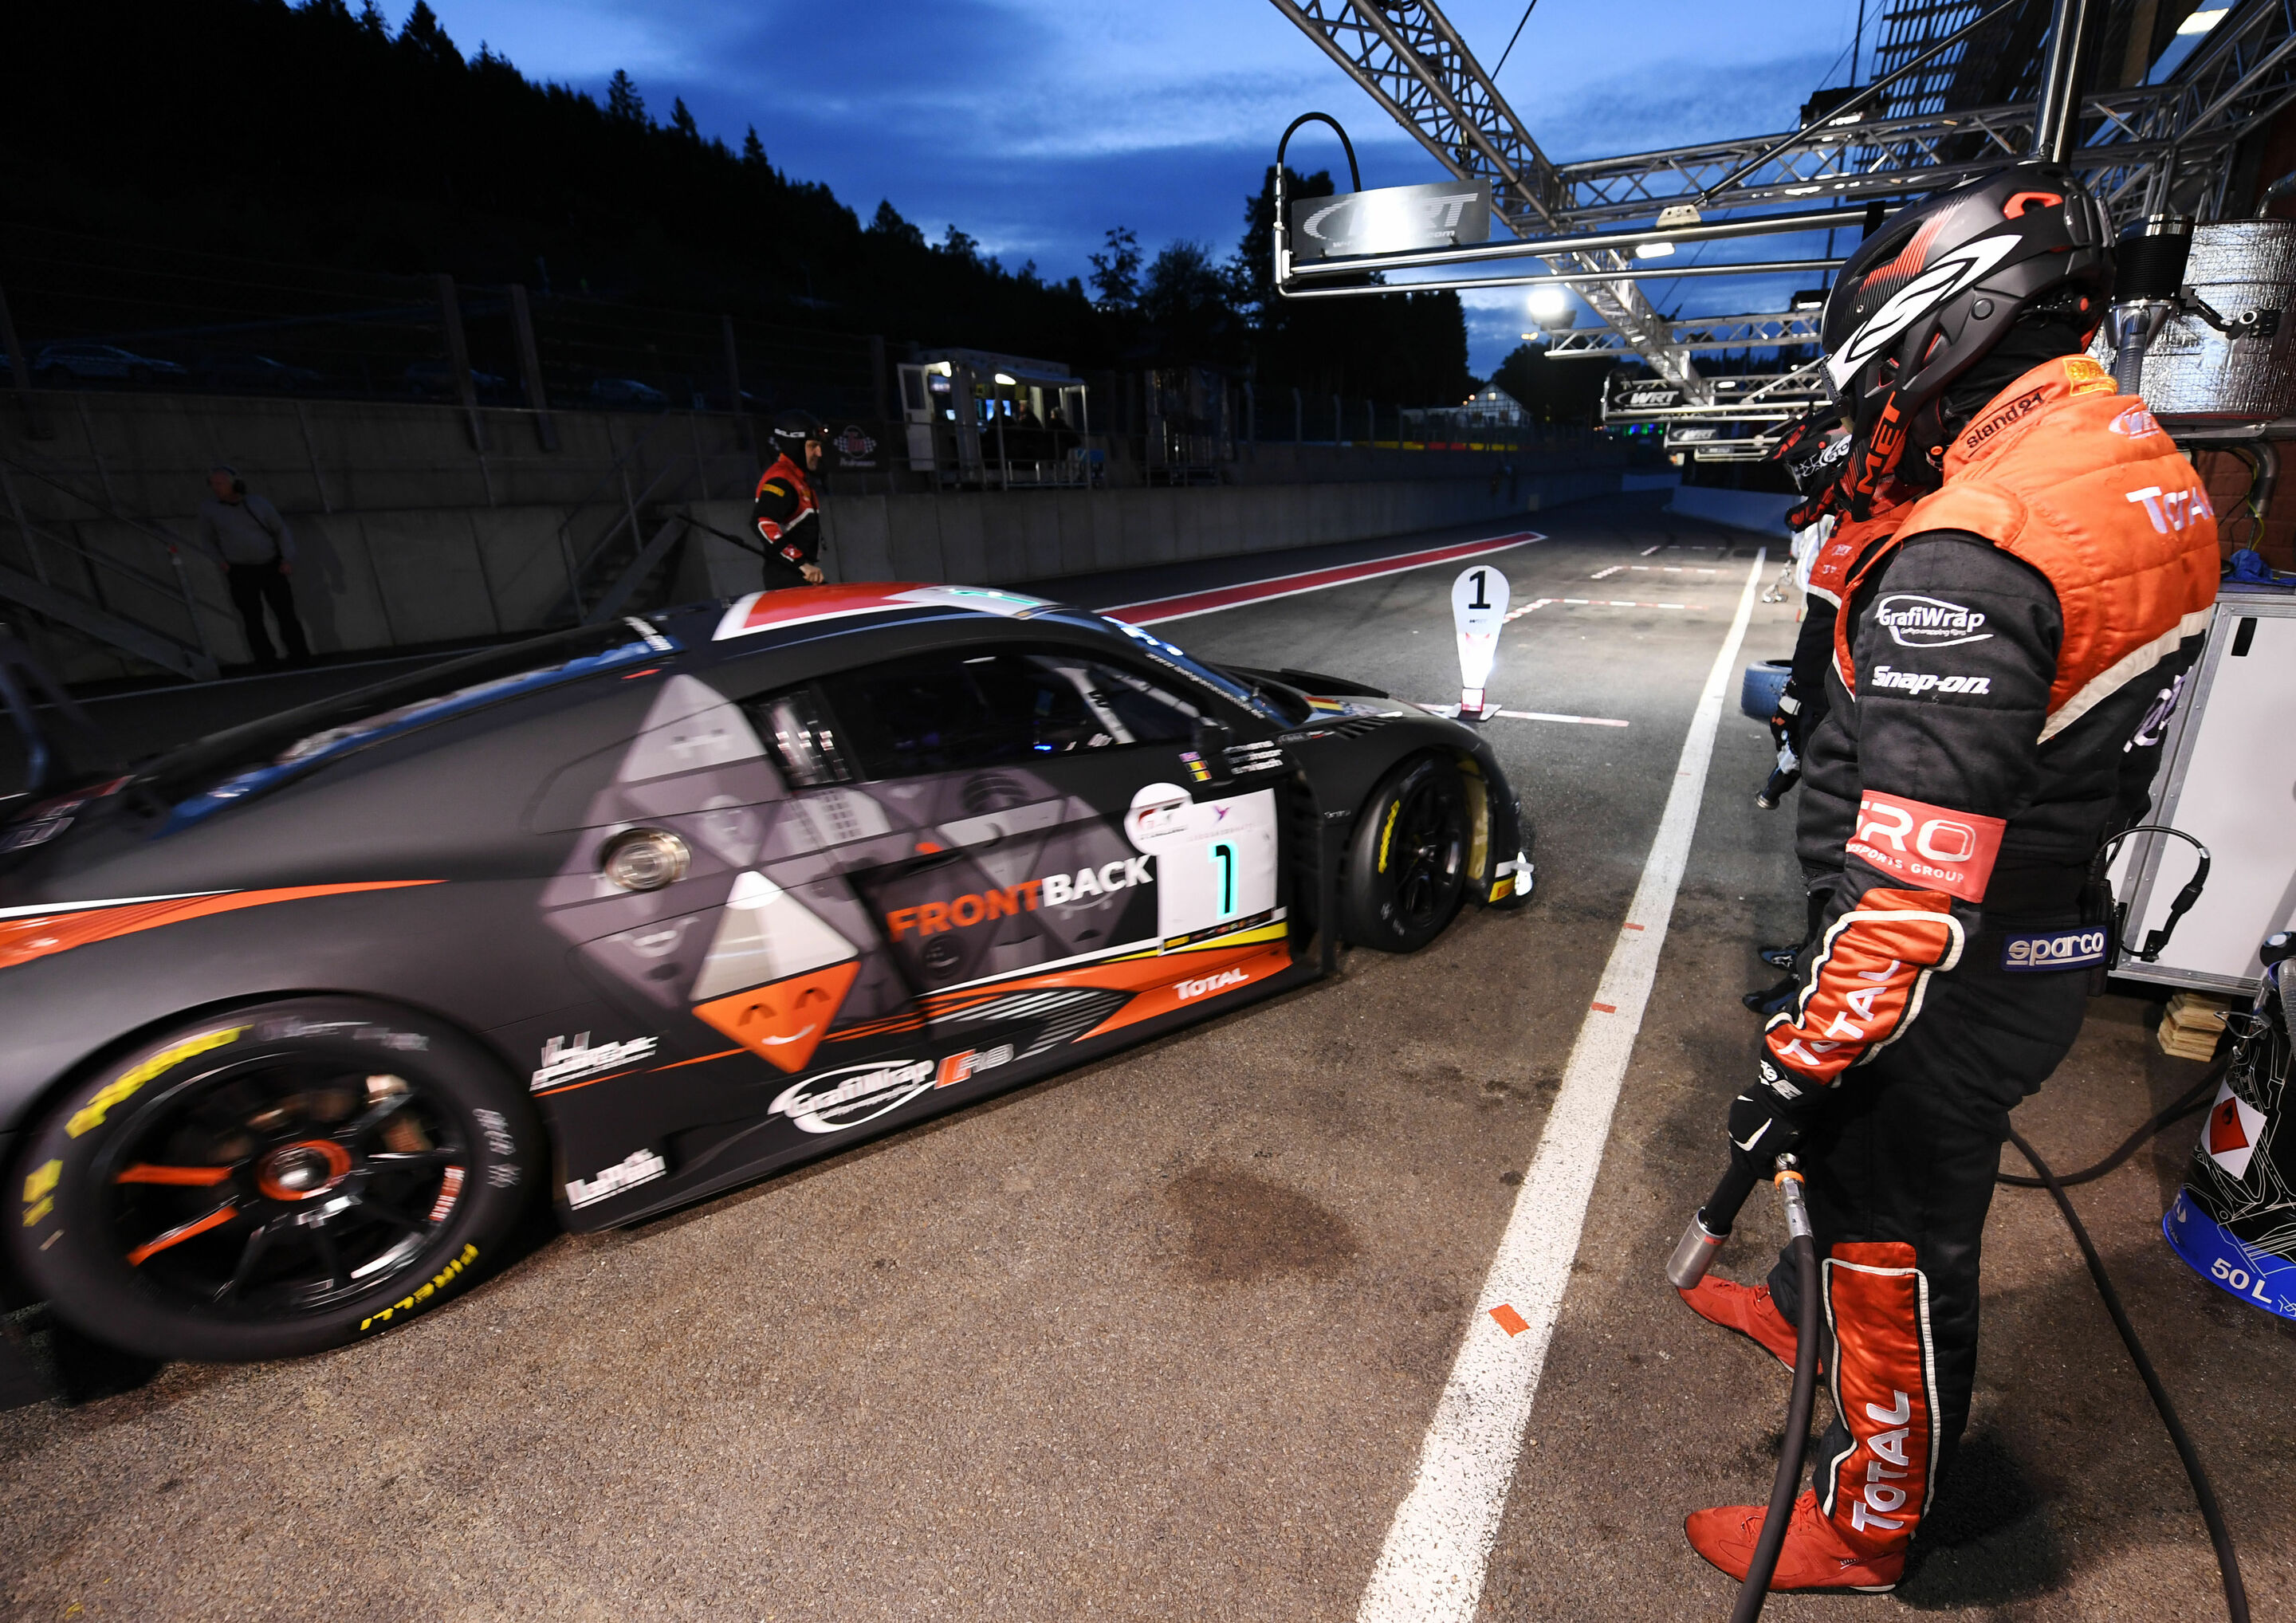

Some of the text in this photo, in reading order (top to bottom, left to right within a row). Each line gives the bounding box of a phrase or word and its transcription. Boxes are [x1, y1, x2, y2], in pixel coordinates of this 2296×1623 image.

[1630, 390, 1679, 404] WRT
[1856, 391, 1901, 494] MET
[2125, 486, 2214, 533] TOTA
[1468, 570, 1491, 609] 1
[1879, 606, 1985, 632] GrafiWrap
[1872, 666, 1991, 694] Snap-on
[1209, 839, 1239, 920] 1
[1911, 863, 1964, 883] GROUP
[2008, 932, 2104, 966] sparco
[1172, 967, 1249, 1000] TOTAL
[1777, 960, 1901, 1066] TOTAL
[2211, 1258, 2272, 1304] 50 L
[1851, 1389, 1911, 1532] TOTAL
